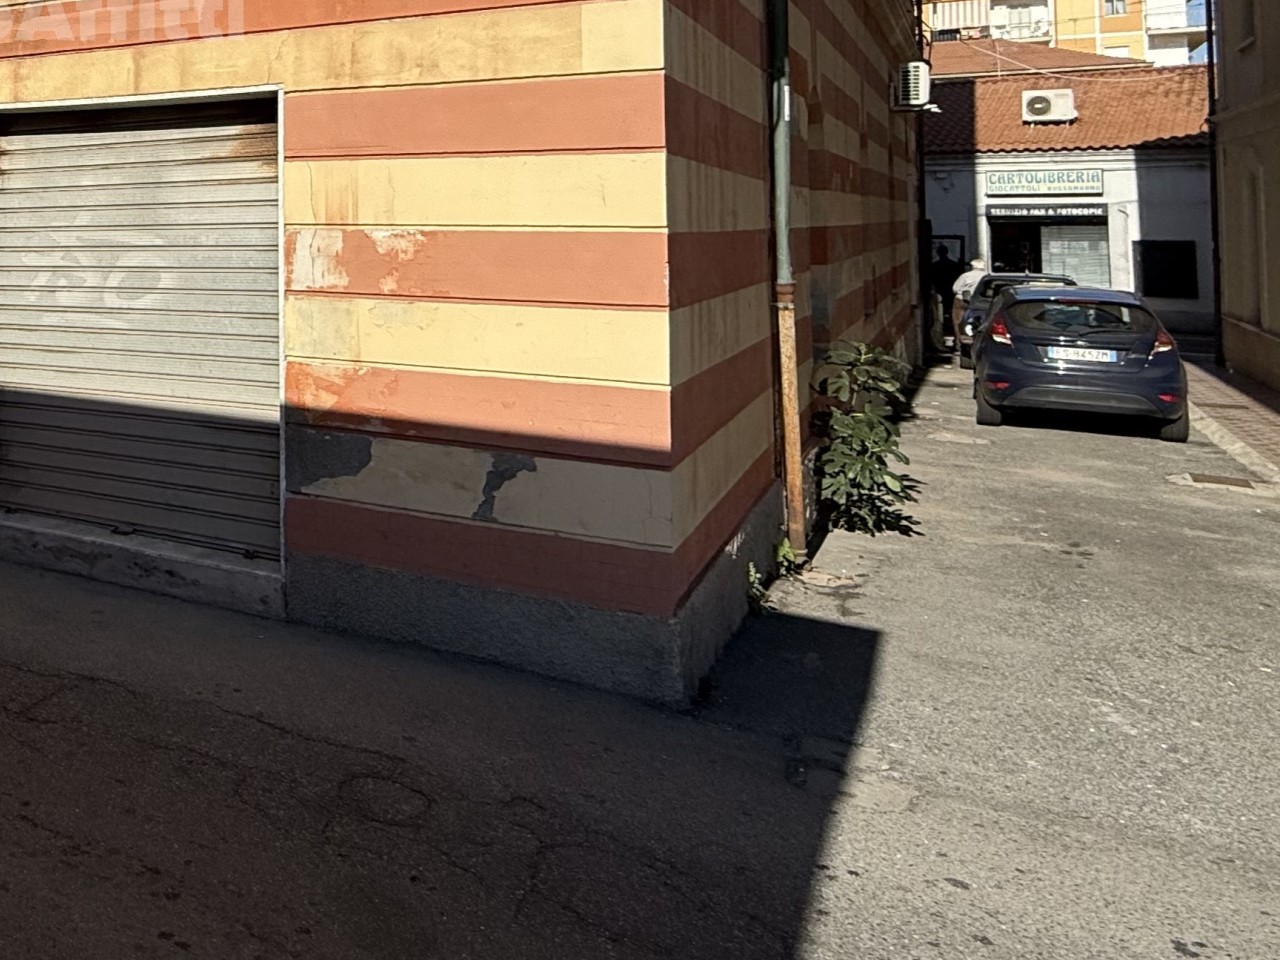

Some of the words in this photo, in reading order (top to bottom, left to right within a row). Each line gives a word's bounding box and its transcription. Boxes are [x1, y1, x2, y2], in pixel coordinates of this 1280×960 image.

[989, 171, 1100, 185] CARTOLIBRERIA
[989, 184, 1041, 192] GIOCATTOLI
[990, 208, 1028, 216] SERVIZIO
[1056, 208, 1103, 216] FOTOCOPIE
